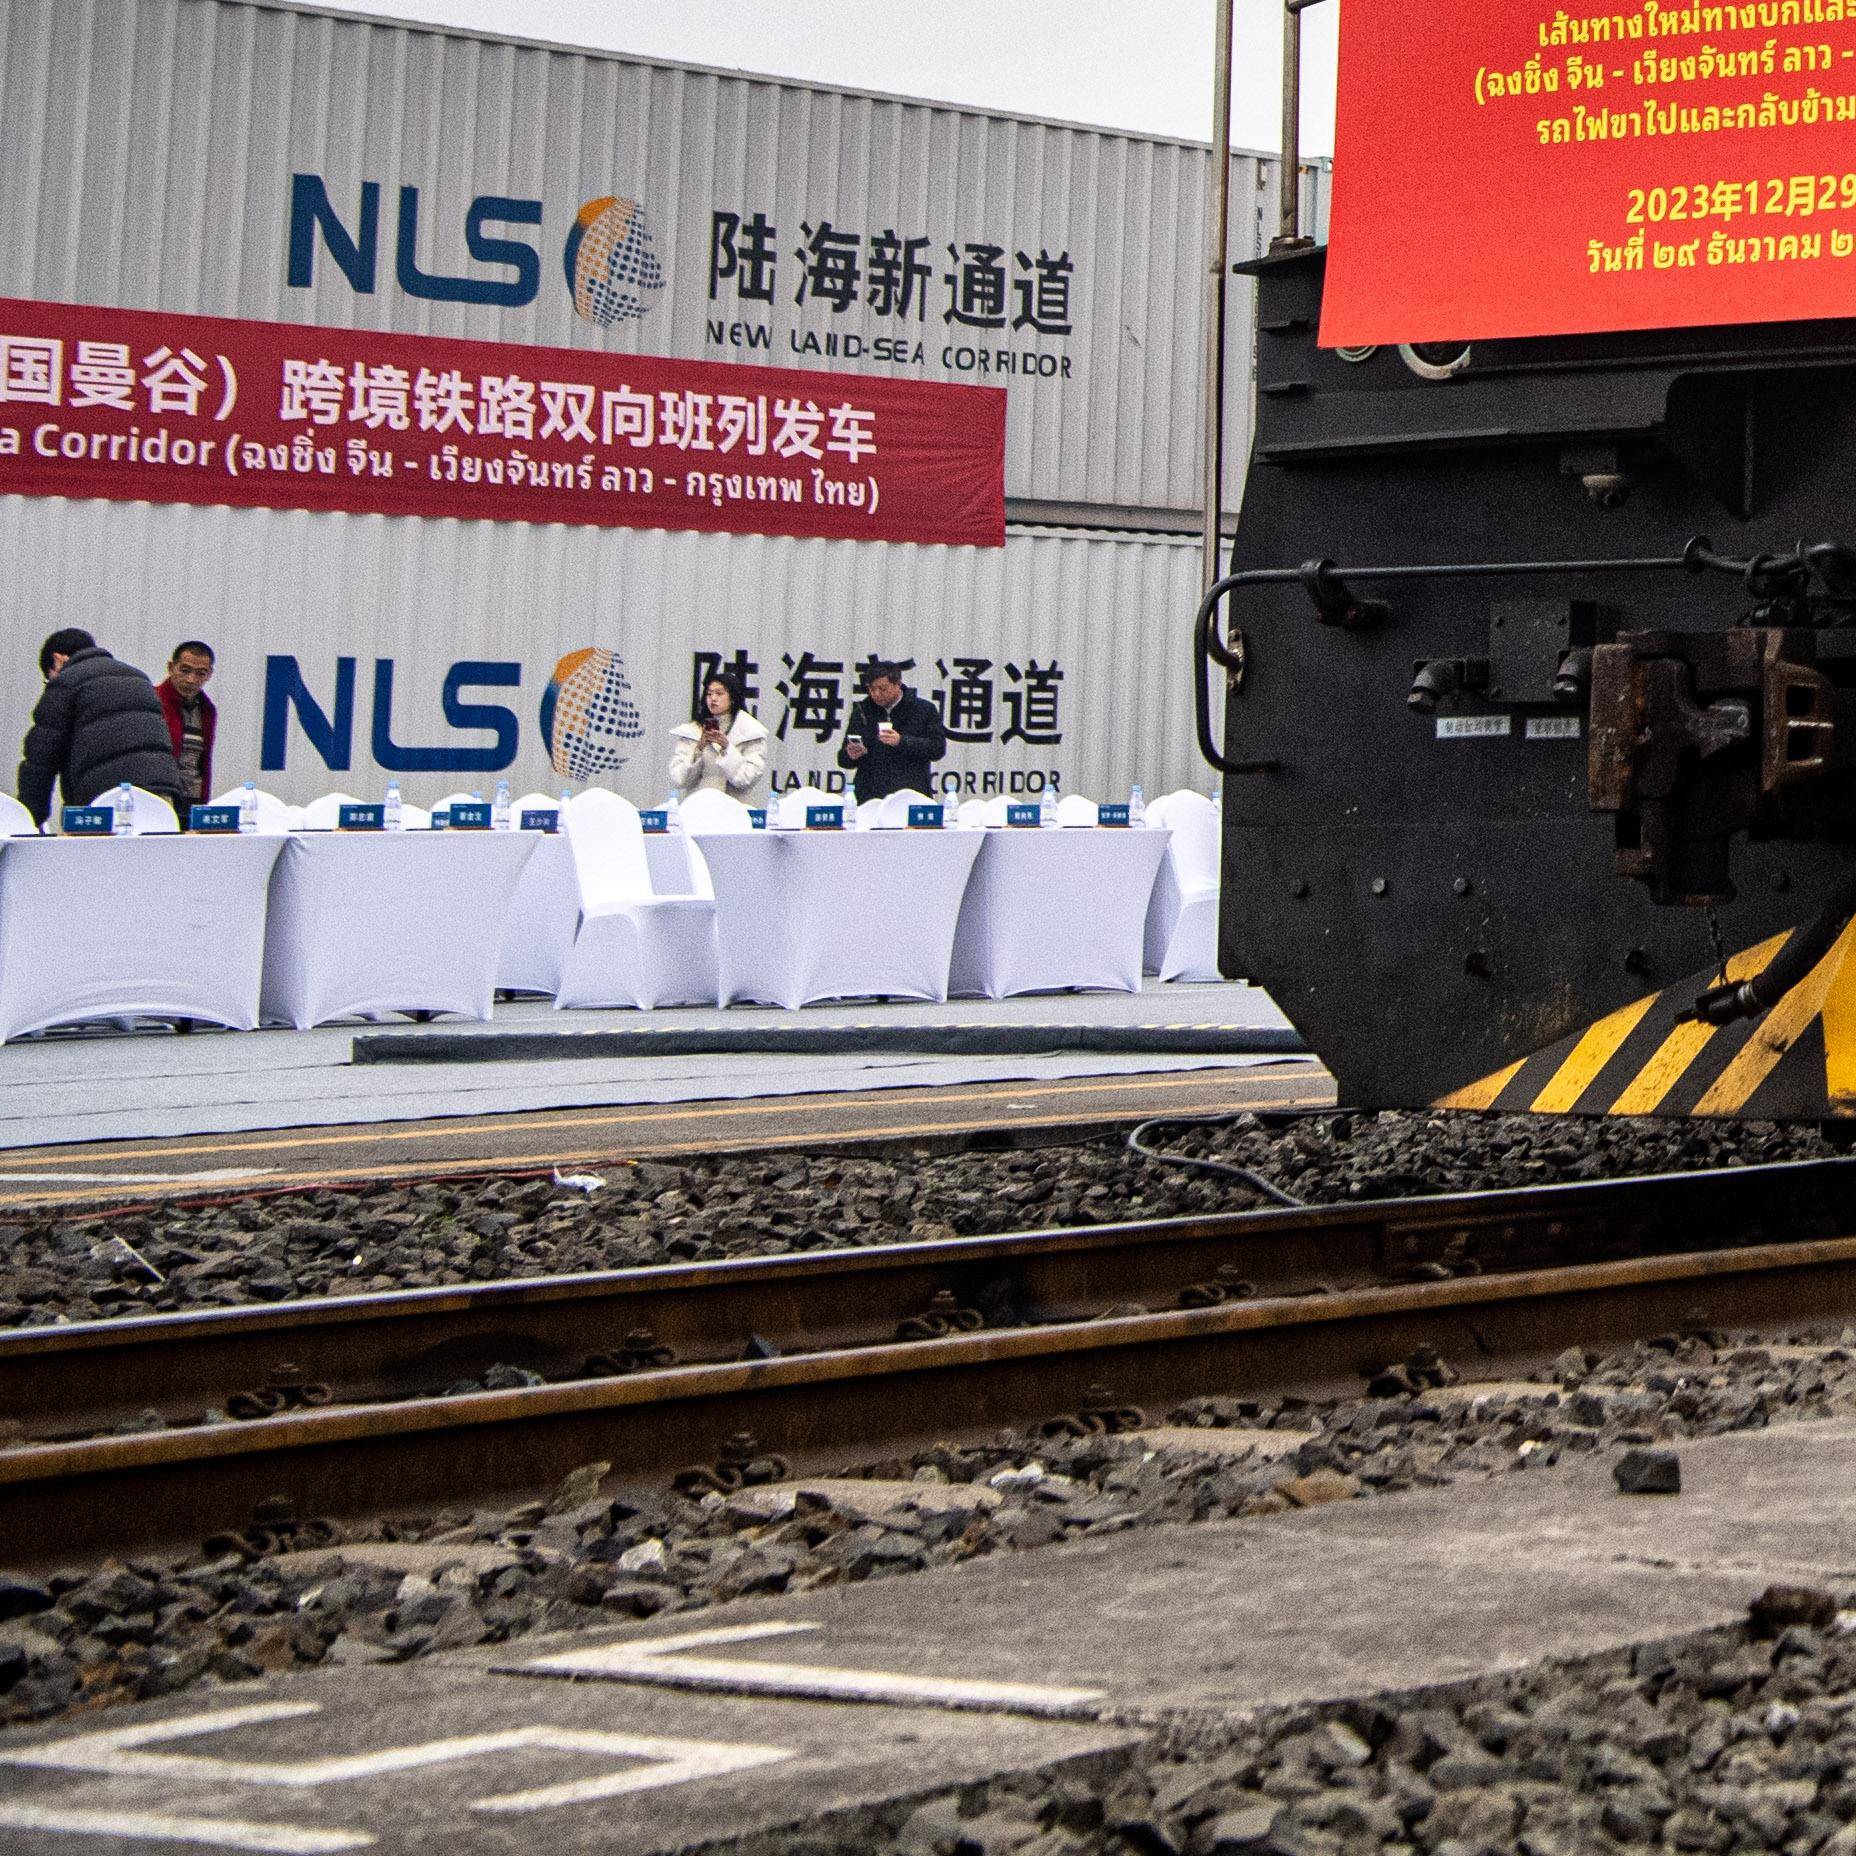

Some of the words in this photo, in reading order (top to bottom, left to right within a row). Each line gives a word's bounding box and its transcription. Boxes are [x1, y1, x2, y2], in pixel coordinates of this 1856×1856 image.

[1474, 54, 1559, 105] (ฉงชิ่ง
[1566, 54, 1604, 92] จีน
[1633, 38, 1777, 85] เวียงจันทร์
[1783, 43, 1832, 72] ลาว
[288, 173, 542, 308] NLS
[708, 210, 1075, 336] 陆海新通道
[1586, 228, 1645, 273] วันที่
[1706, 230, 1821, 266] ธันวาคม
[706, 318, 773, 350] NEW
[790, 328, 925, 367] LAND-SEA
[942, 344, 1072, 379] CORRIDOR
[33, 423, 216, 467] Corridor
[346, 438, 393, 478] จีน
[600, 466, 653, 494] ลาว
[686, 470, 802, 507] กรุงเทพ
[811, 468, 880, 514] ไทย)
[260, 654, 522, 773] NLS
